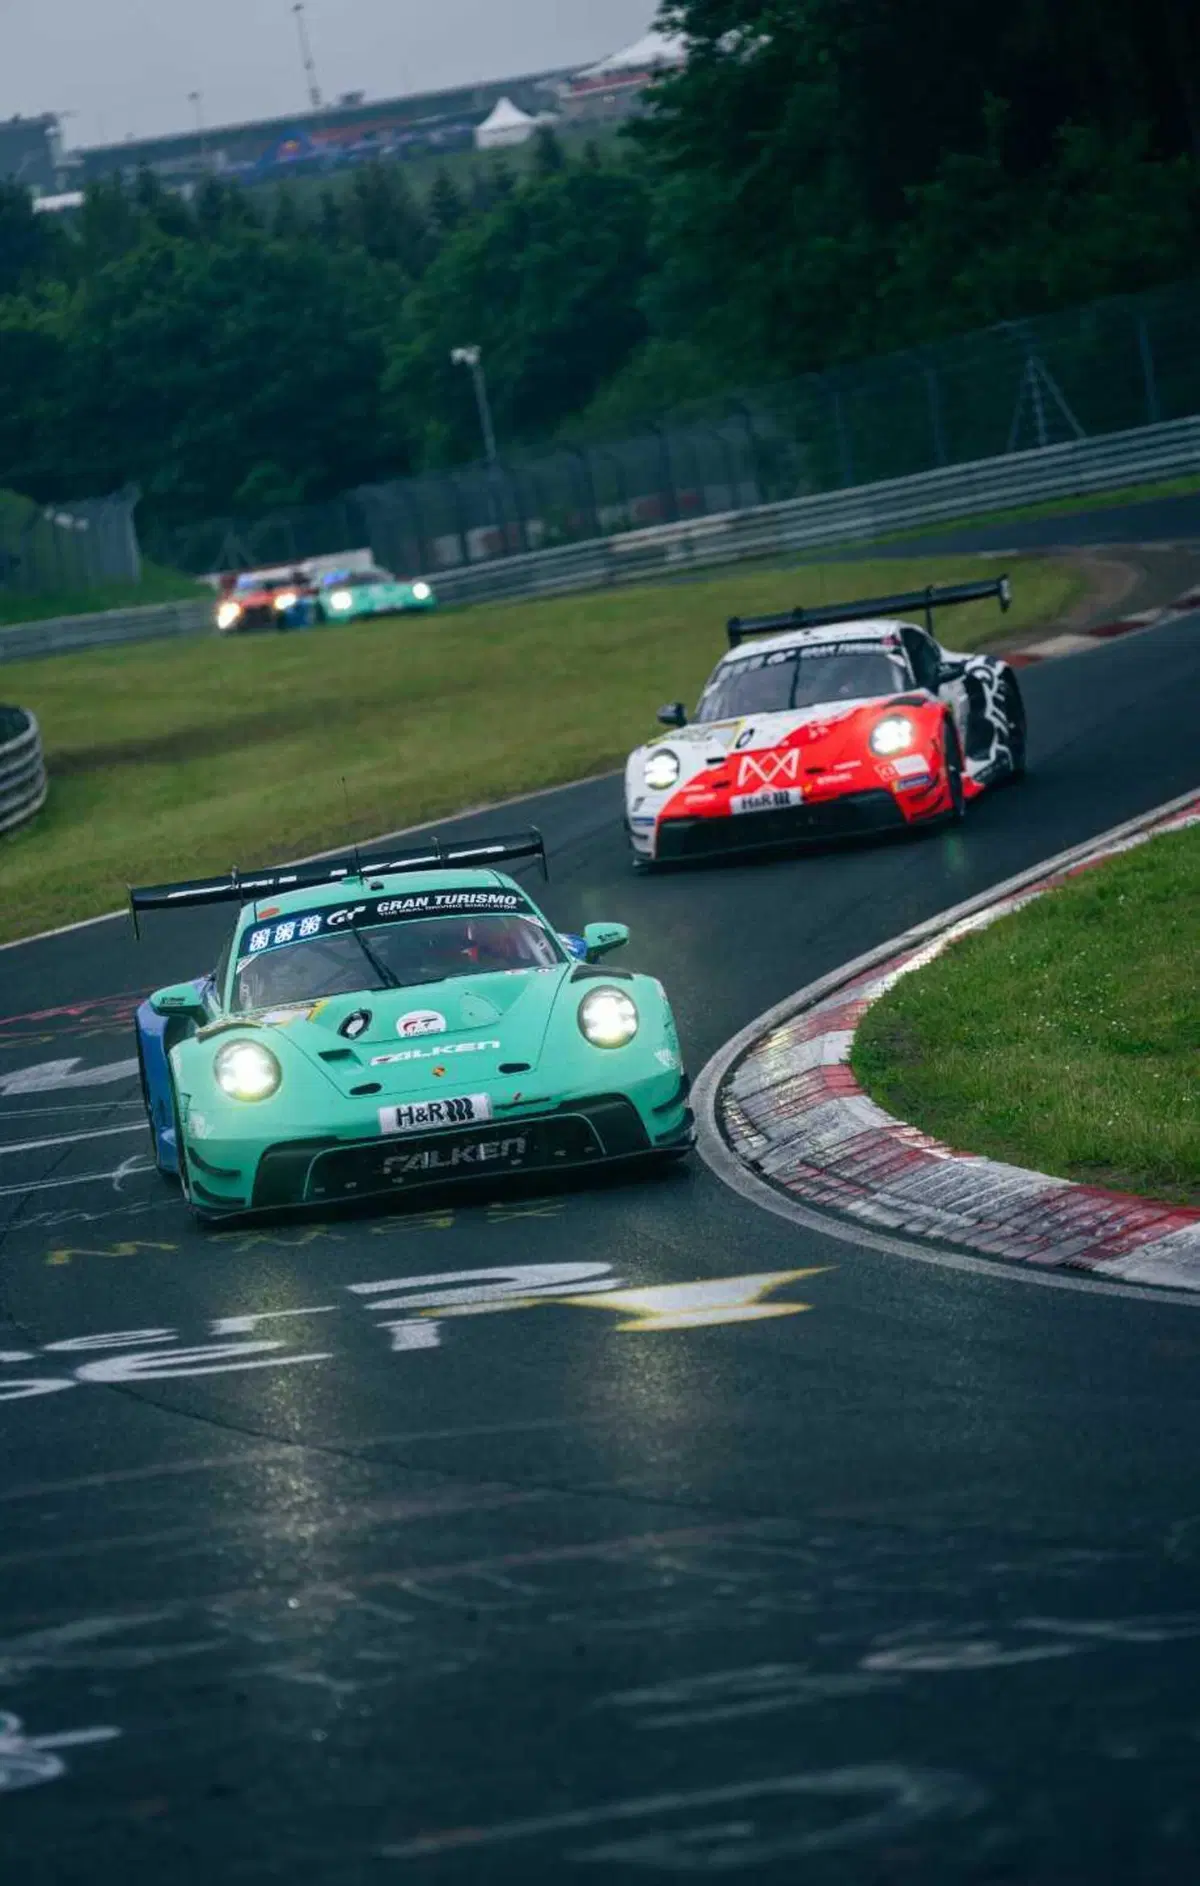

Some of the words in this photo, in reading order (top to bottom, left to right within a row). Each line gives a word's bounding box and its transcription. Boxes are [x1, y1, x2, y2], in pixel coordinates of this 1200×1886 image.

[377, 897, 429, 912] GRAN
[434, 894, 517, 906] TURISMO
[370, 1040, 501, 1066] FALKEN
[396, 1101, 444, 1127] H&R
[382, 1136, 527, 1175] FALKEN
